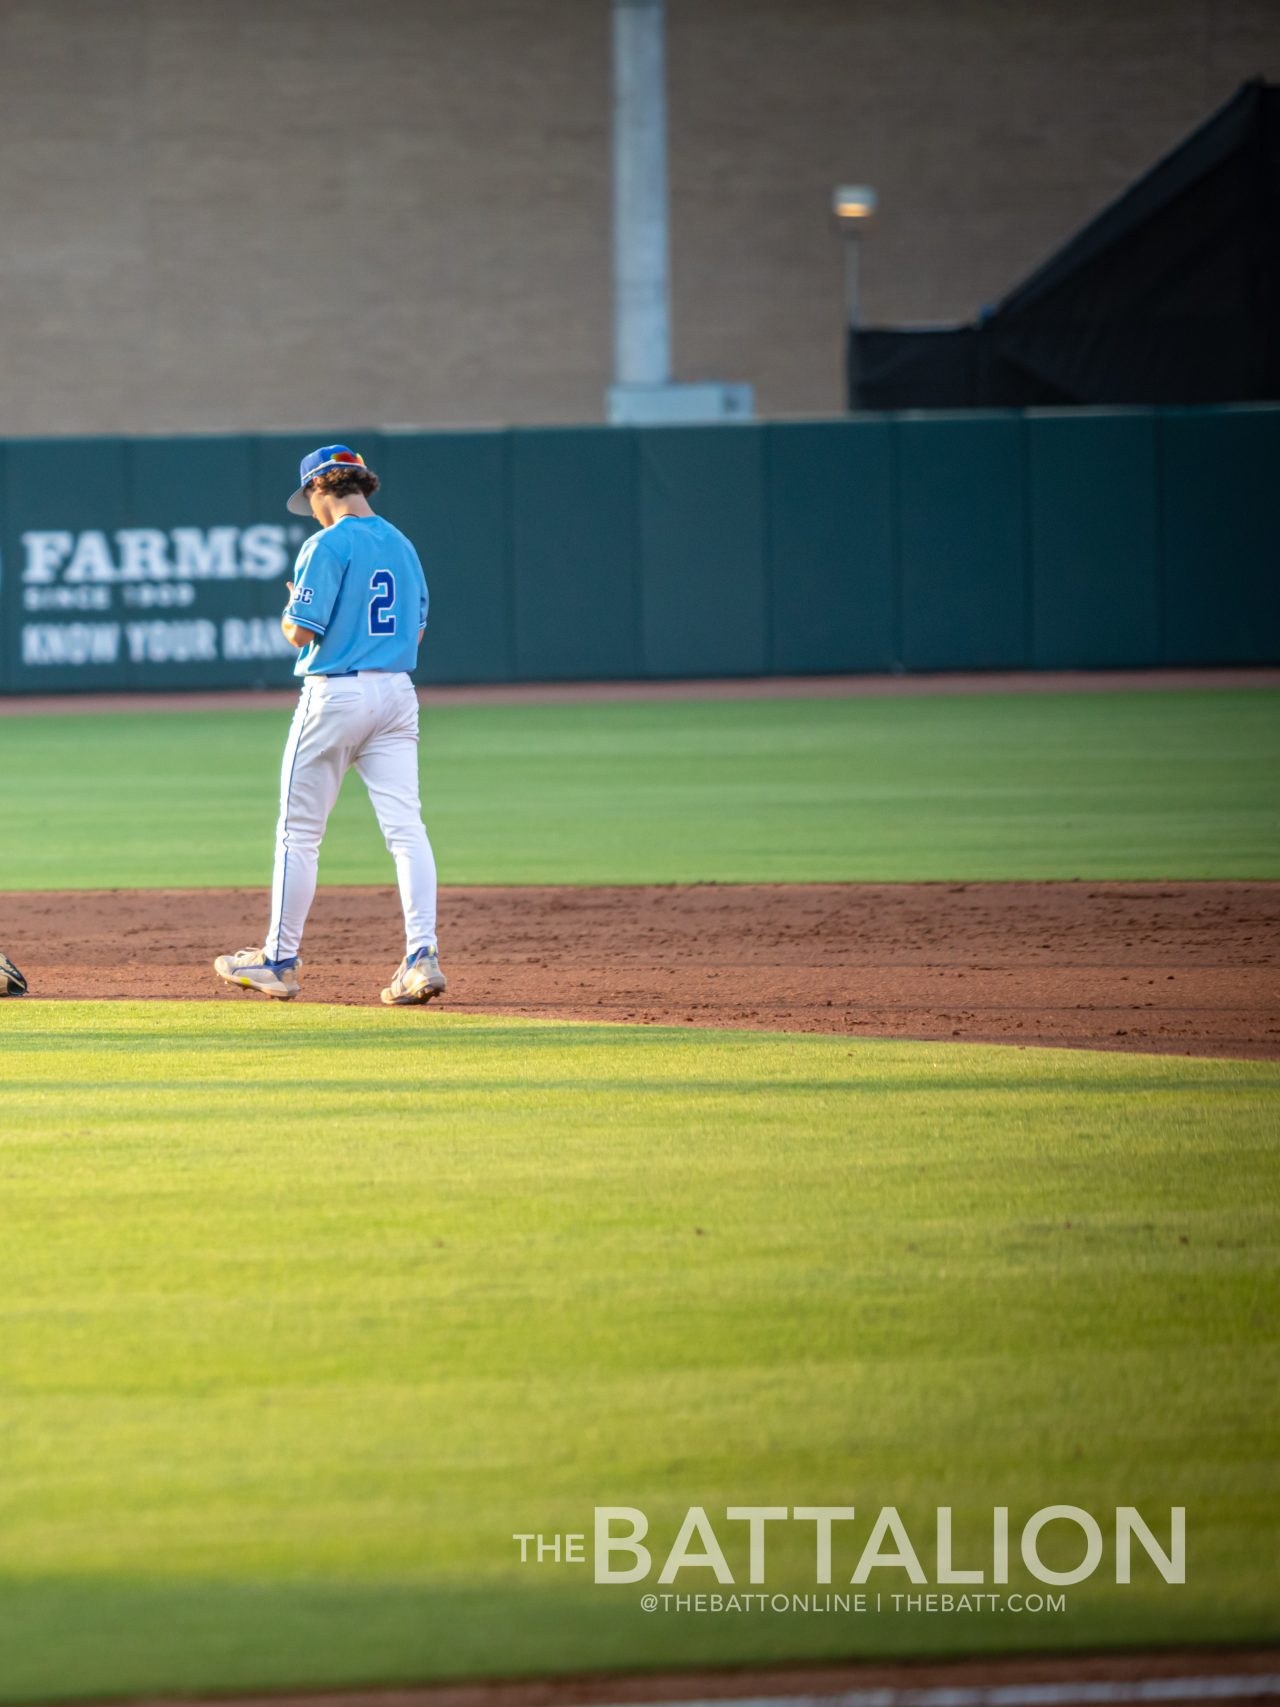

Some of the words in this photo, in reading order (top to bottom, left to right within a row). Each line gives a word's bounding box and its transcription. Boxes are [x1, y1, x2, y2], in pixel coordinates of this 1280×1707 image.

[22, 528, 289, 583] FARMS
[369, 570, 396, 636] 2
[23, 622, 118, 663] KNOW
[126, 620, 216, 662] YOUR
[223, 618, 298, 660] RAN
